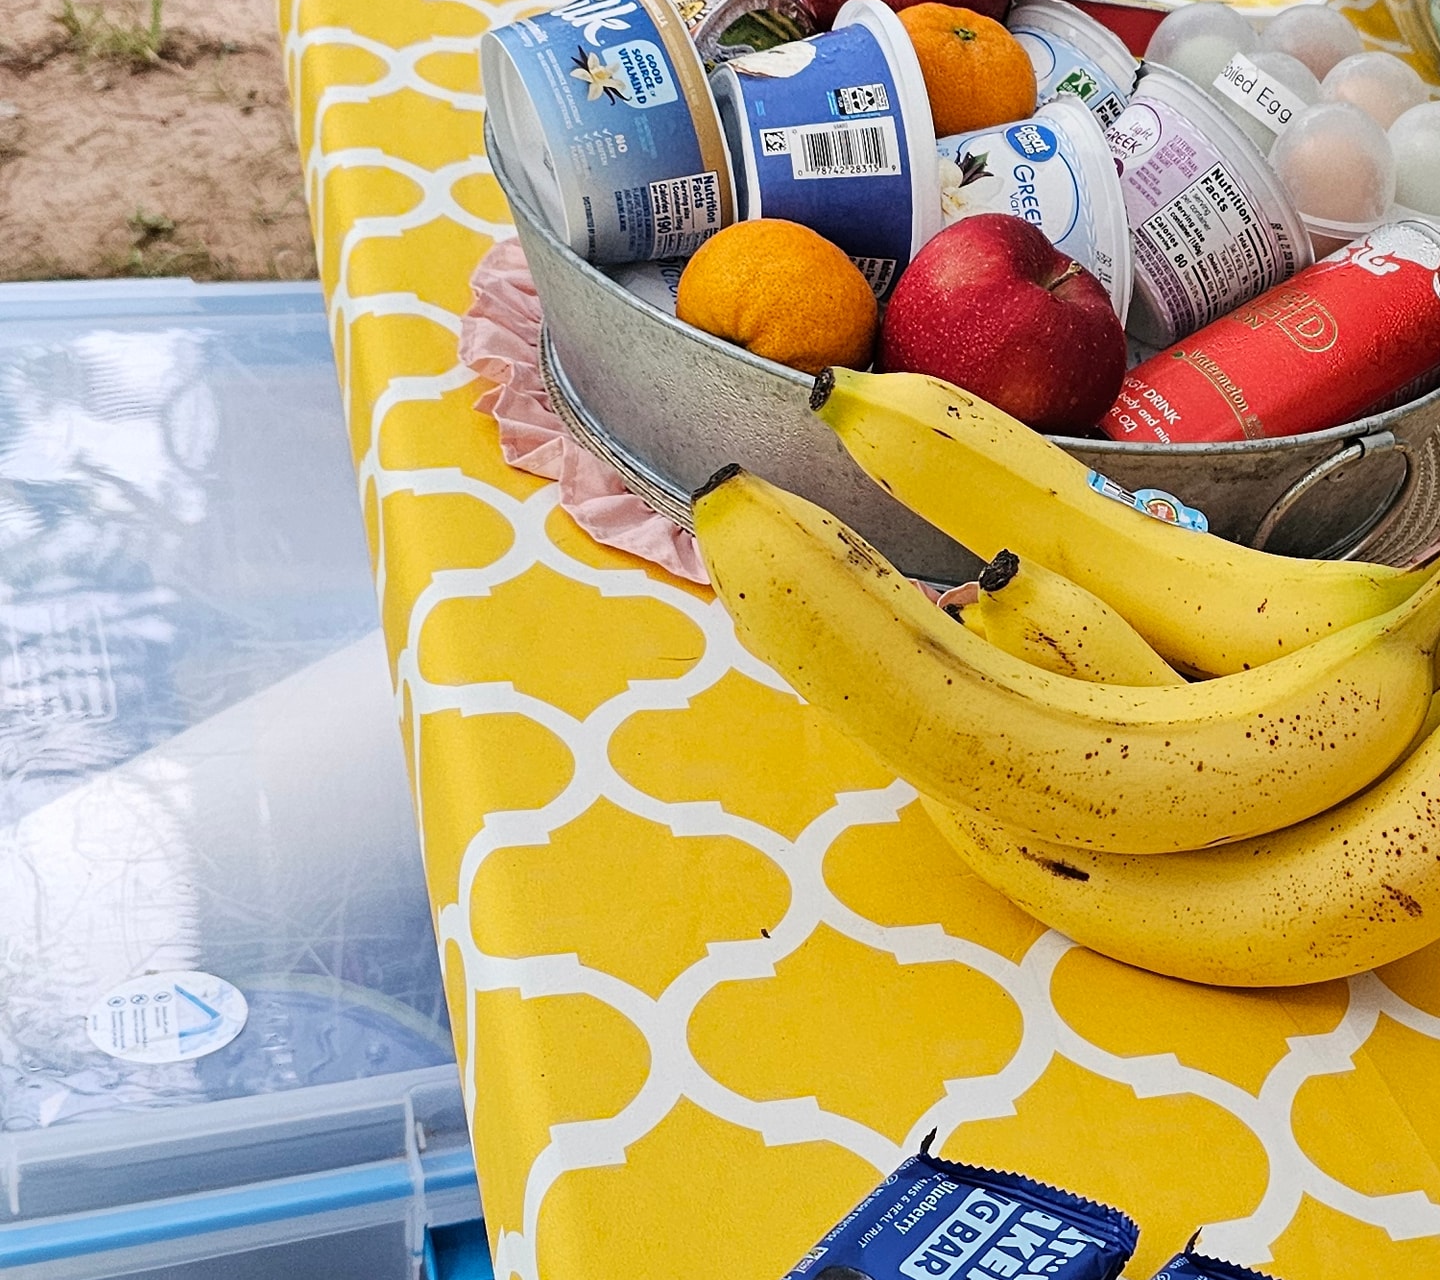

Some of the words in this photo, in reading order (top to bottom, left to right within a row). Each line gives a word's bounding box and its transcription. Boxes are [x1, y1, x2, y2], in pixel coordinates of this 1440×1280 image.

[618, 48, 642, 97] VITAMIN
[636, 95, 647, 105] D
[632, 48, 656, 91] SOURCE
[646, 54, 664, 85] GOOD
[1257, 87, 1293, 124] Egg
[615, 134, 629, 153] NO
[1015, 132, 1036, 155] Value
[1020, 125, 1050, 153] Great
[1106, 128, 1143, 154] GREEK
[1128, 121, 1154, 142] Light
[595, 139, 608, 166] GLUTEN
[1185, 156, 1199, 172] THAN
[815, 165, 845, 175] 78742
[850, 164, 880, 174] 28315
[891, 164, 897, 172] 9
[658, 183, 670, 214] Calories
[673, 186, 682, 216] Container
[680, 180, 689, 206] Serving
[692, 178, 704, 209] Facts
[702, 175, 715, 224] Nutrition
[1014, 164, 1042, 226] GREE
[1193, 191, 1213, 218] serving
[1200, 176, 1229, 213] Facts
[1209, 167, 1252, 226] Nutrition
[656, 215, 672, 234] 190
[683, 206, 691, 220] size
[1173, 199, 1196, 231] Serving
[1194, 227, 1206, 243] size
[1180, 193, 1193, 206] per
[1190, 203, 1212, 232] container
[1147, 221, 1158, 233] per
[1154, 230, 1172, 252] serving
[1153, 216, 1179, 248] Calories
[1173, 253, 1189, 270] 80
[1169, 210, 1194, 242] container
[1187, 235, 1204, 258] (150g)
[1235, 232, 1250, 249] Total
[1243, 248, 1254, 259] Fat
[1193, 259, 1212, 282] Sodium
[1188, 347, 1250, 414] Watermelon
[1119, 391, 1140, 412] body
[1139, 404, 1161, 429] and
[1144, 389, 1182, 426] DRINK
[878, 1199, 903, 1223] REAL
[895, 1180, 960, 1236] Blueberry
[965, 1188, 1013, 1225] IG
[857, 1223, 884, 1249] FRUIT
[913, 1219, 982, 1275] BAR
